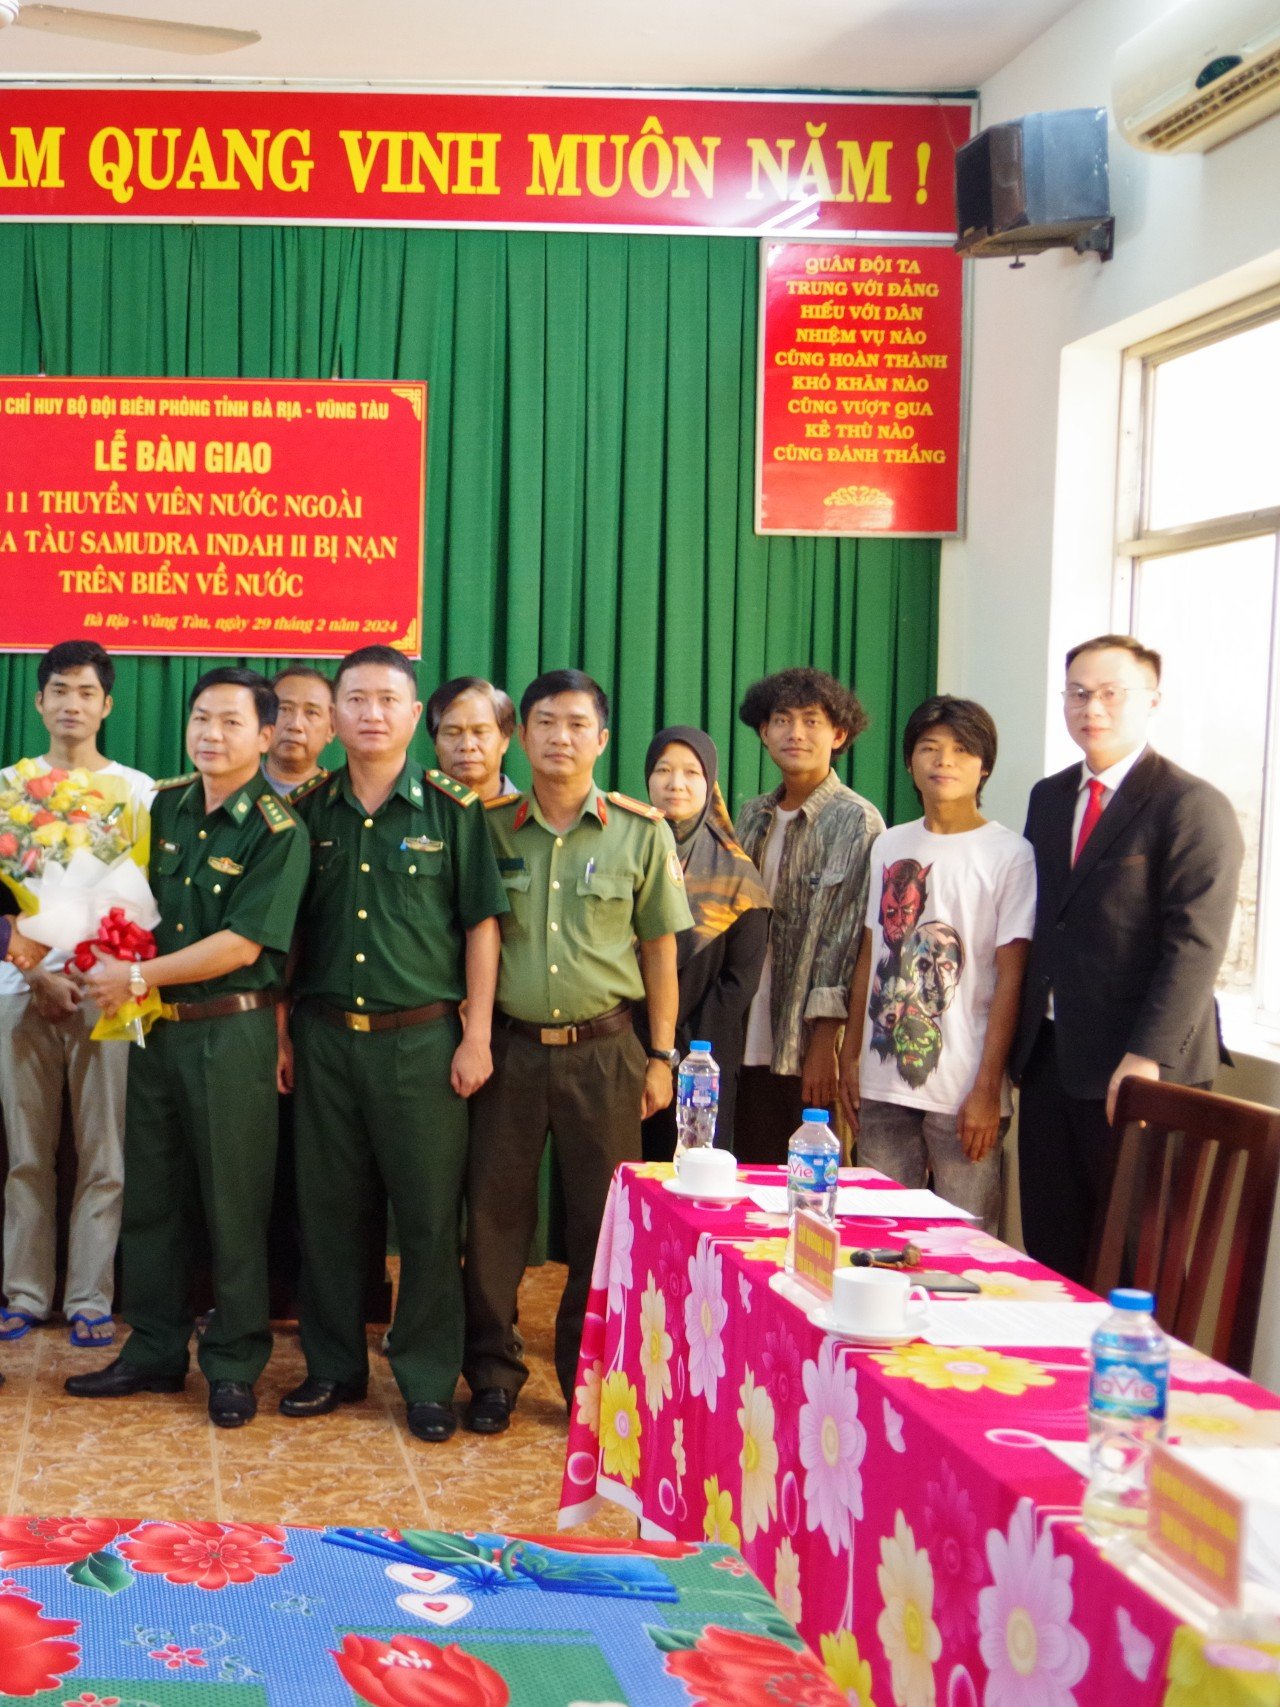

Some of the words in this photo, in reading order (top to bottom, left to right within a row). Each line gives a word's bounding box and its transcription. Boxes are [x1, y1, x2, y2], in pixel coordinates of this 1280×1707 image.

[89, 127, 313, 203] QUANG
[339, 130, 501, 195] VINH
[526, 115, 720, 200] MUÔN
[745, 121, 892, 204] NĂM
[916, 142, 930, 204] !
[805, 253, 855, 276] QUÂN
[860, 255, 892, 275] ĐỘI
[897, 259, 921, 274] TA
[786, 280, 848, 295] TRUNG
[851, 279, 883, 296] VỚI
[888, 278, 939, 297] ĐẢNG
[801, 299, 845, 319] HIẾU
[849, 303, 881, 320] VỚI
[885, 306, 923, 320] DÂN
[796, 326, 856, 345] NHIỆM
[860, 330, 885, 346] VỤ
[890, 327, 926, 344] NÀO
[775, 349, 825, 366] CŨNG
[829, 350, 879, 367] HOÀN
[883, 351, 947, 368] THÀNH
[792, 373, 831, 390] KHÓ
[836, 374, 888, 391] KHĂN
[892, 375, 929, 392] NÀO
[5, 393, 30, 414] CHỈ
[34, 398, 63, 414] HUY
[67, 395, 87, 418] BỘ
[91, 396, 116, 419] ĐỘI
[120, 396, 155, 416] BIÊN
[159, 396, 210, 416] PHÒNG
[213, 395, 249, 417] TỈNH
[252, 398, 273, 417] BÀ
[276, 401, 302, 422] RỊA
[316, 399, 356, 419] VŨNG
[360, 400, 389, 419] TÀU
[788, 397, 838, 414] CŨNG
[842, 400, 890, 418] VƯỢT
[894, 402, 933, 419] QUA
[805, 420, 831, 438] KẺ
[835, 421, 873, 438] THÙ
[877, 422, 914, 439] NÀO
[95, 429, 127, 471] LỄ
[136, 434, 196, 472] BÀN
[205, 441, 271, 474] GIAO
[774, 445, 823, 461] CŨNG
[827, 445, 879, 462] ĐÁNH
[883, 443, 946, 464] THẮNG
[7, 492, 29, 512] 11
[39, 481, 138, 514] THUYỀN
[145, 486, 203, 515] VIÊN
[210, 487, 277, 517] NƯỚC
[284, 489, 362, 518] NGOÀI
[24, 524, 75, 553] TÀU
[81, 531, 199, 555] SAMUDRA
[207, 533, 286, 556] INDAH
[291, 535, 307, 557] II
[314, 535, 338, 563] BỊ
[345, 536, 397, 564] NẠN
[59, 564, 125, 593] TRÊN
[131, 560, 189, 594] BIỂN
[196, 562, 229, 595] VỀ
[235, 567, 303, 597] NƯỚC
[84, 613, 103, 627] Bà
[106, 614, 129, 629] Rịa
[143, 614, 178, 631] Vũng
[182, 614, 211, 629] Tàu,
[215, 615, 249, 632] ngày
[252, 618, 272, 630] 29
[274, 616, 314, 633] tháng
[316, 619, 326, 631] 2
[329, 618, 360, 631] năm
[362, 620, 397, 632] 2024
